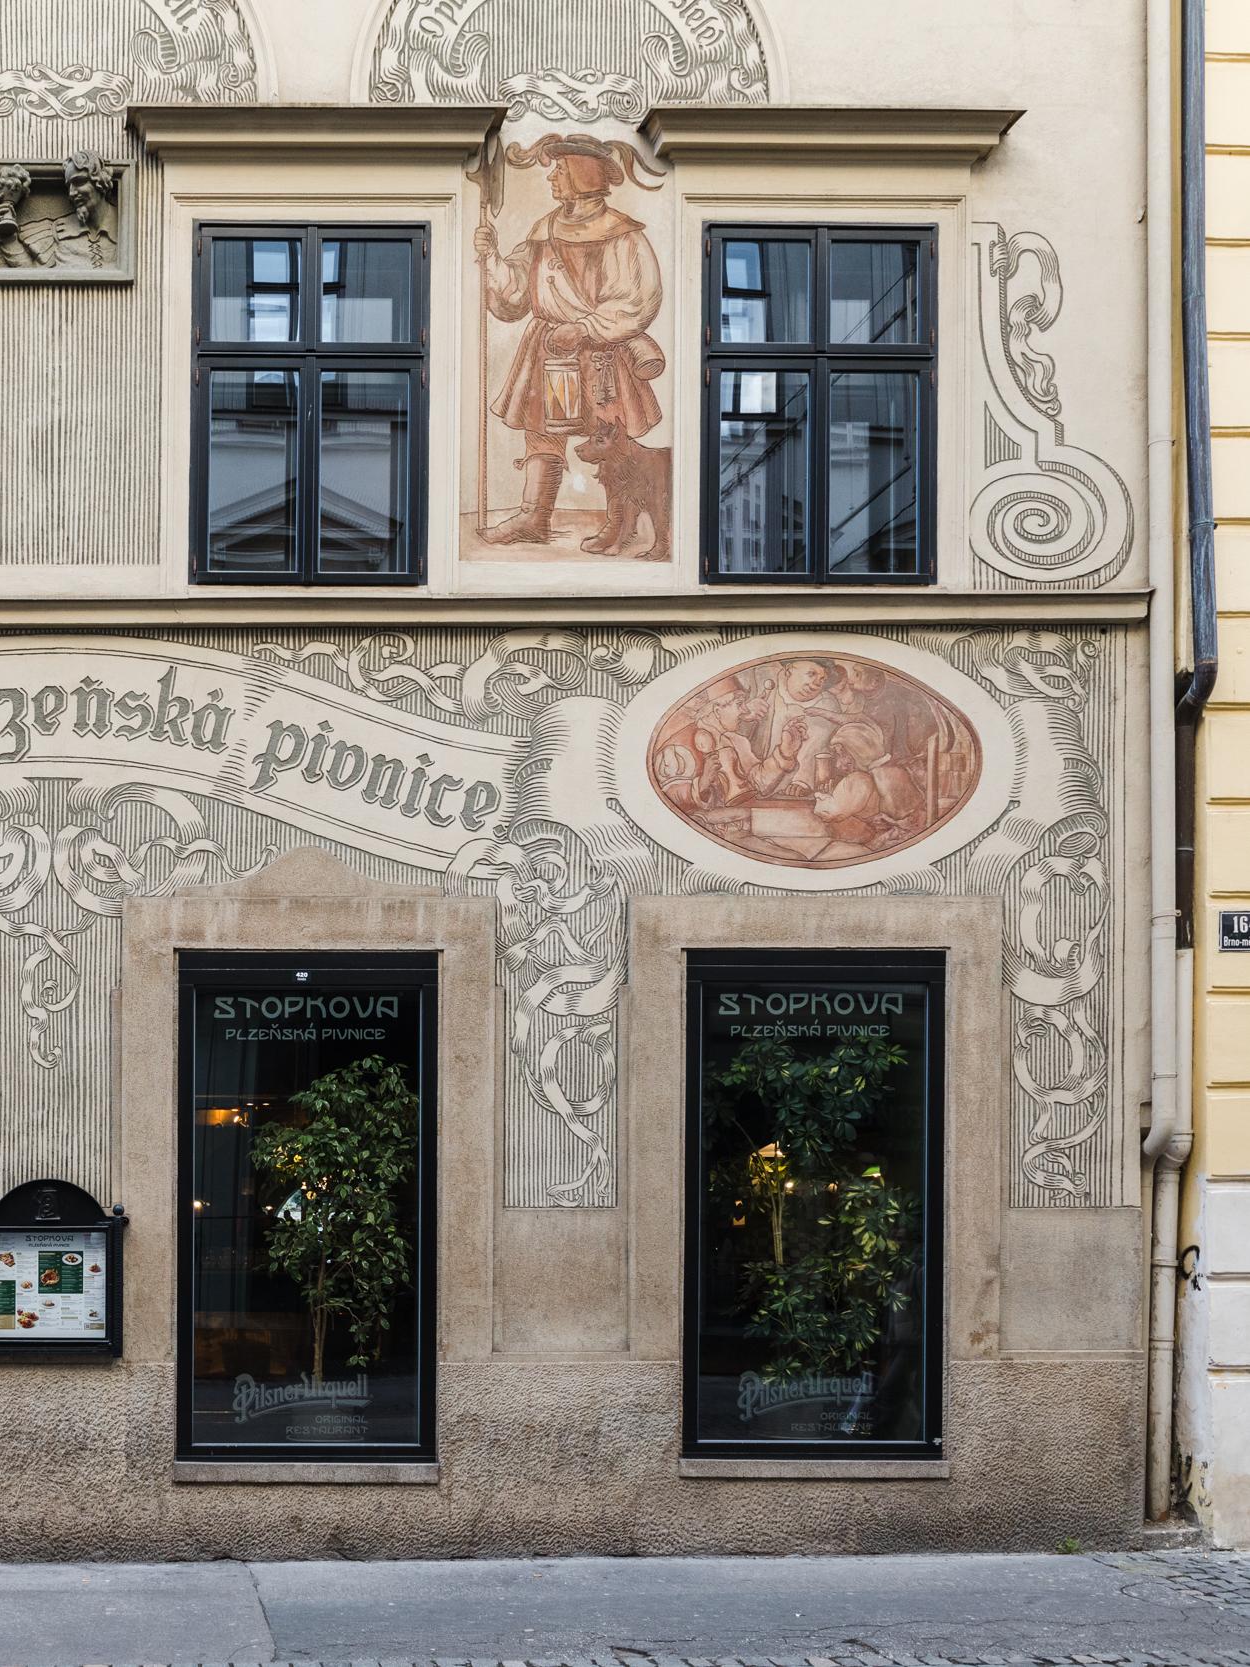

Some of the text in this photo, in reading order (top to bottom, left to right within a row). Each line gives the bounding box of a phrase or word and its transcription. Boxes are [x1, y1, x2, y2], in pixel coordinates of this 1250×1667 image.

[1233, 915, 1250, 933] 16
[1223, 936, 1250, 947] Brno-m
[213, 996, 399, 1019] STOPKOVA
[718, 993, 903, 1015] STOPKOVA
[225, 1023, 386, 1041] PLZEŇSKÁ PIVNICE
[730, 1019, 891, 1037] PLZEŇSKÁ PIVNICE
[233, 1371, 368, 1424] Pilsner Urquell
[315, 1415, 368, 1424] ORIGINAL
